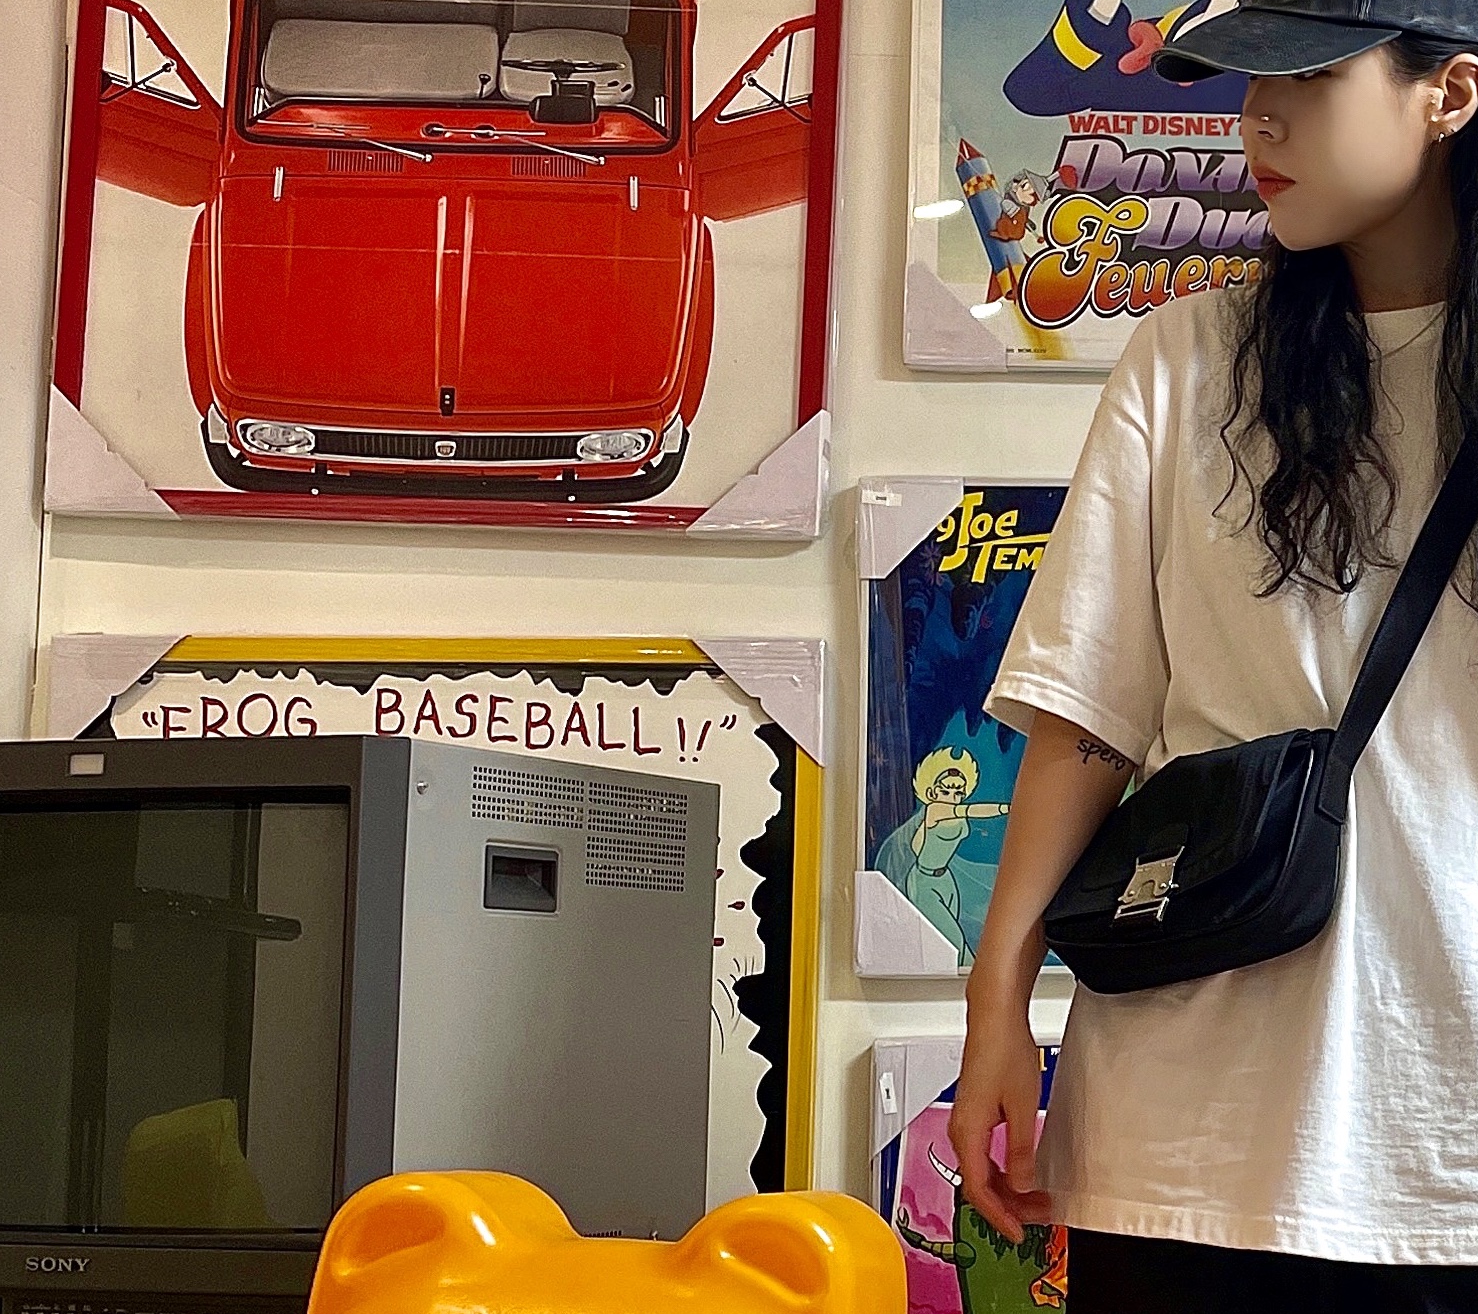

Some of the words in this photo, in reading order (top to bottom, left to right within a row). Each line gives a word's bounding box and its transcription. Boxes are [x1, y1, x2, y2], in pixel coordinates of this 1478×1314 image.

[1069, 114, 1138, 136] WALT
[1142, 116, 1237, 137] DISNEY
[939, 491, 1019, 572] Joe
[25, 1256, 91, 1272] SONY
